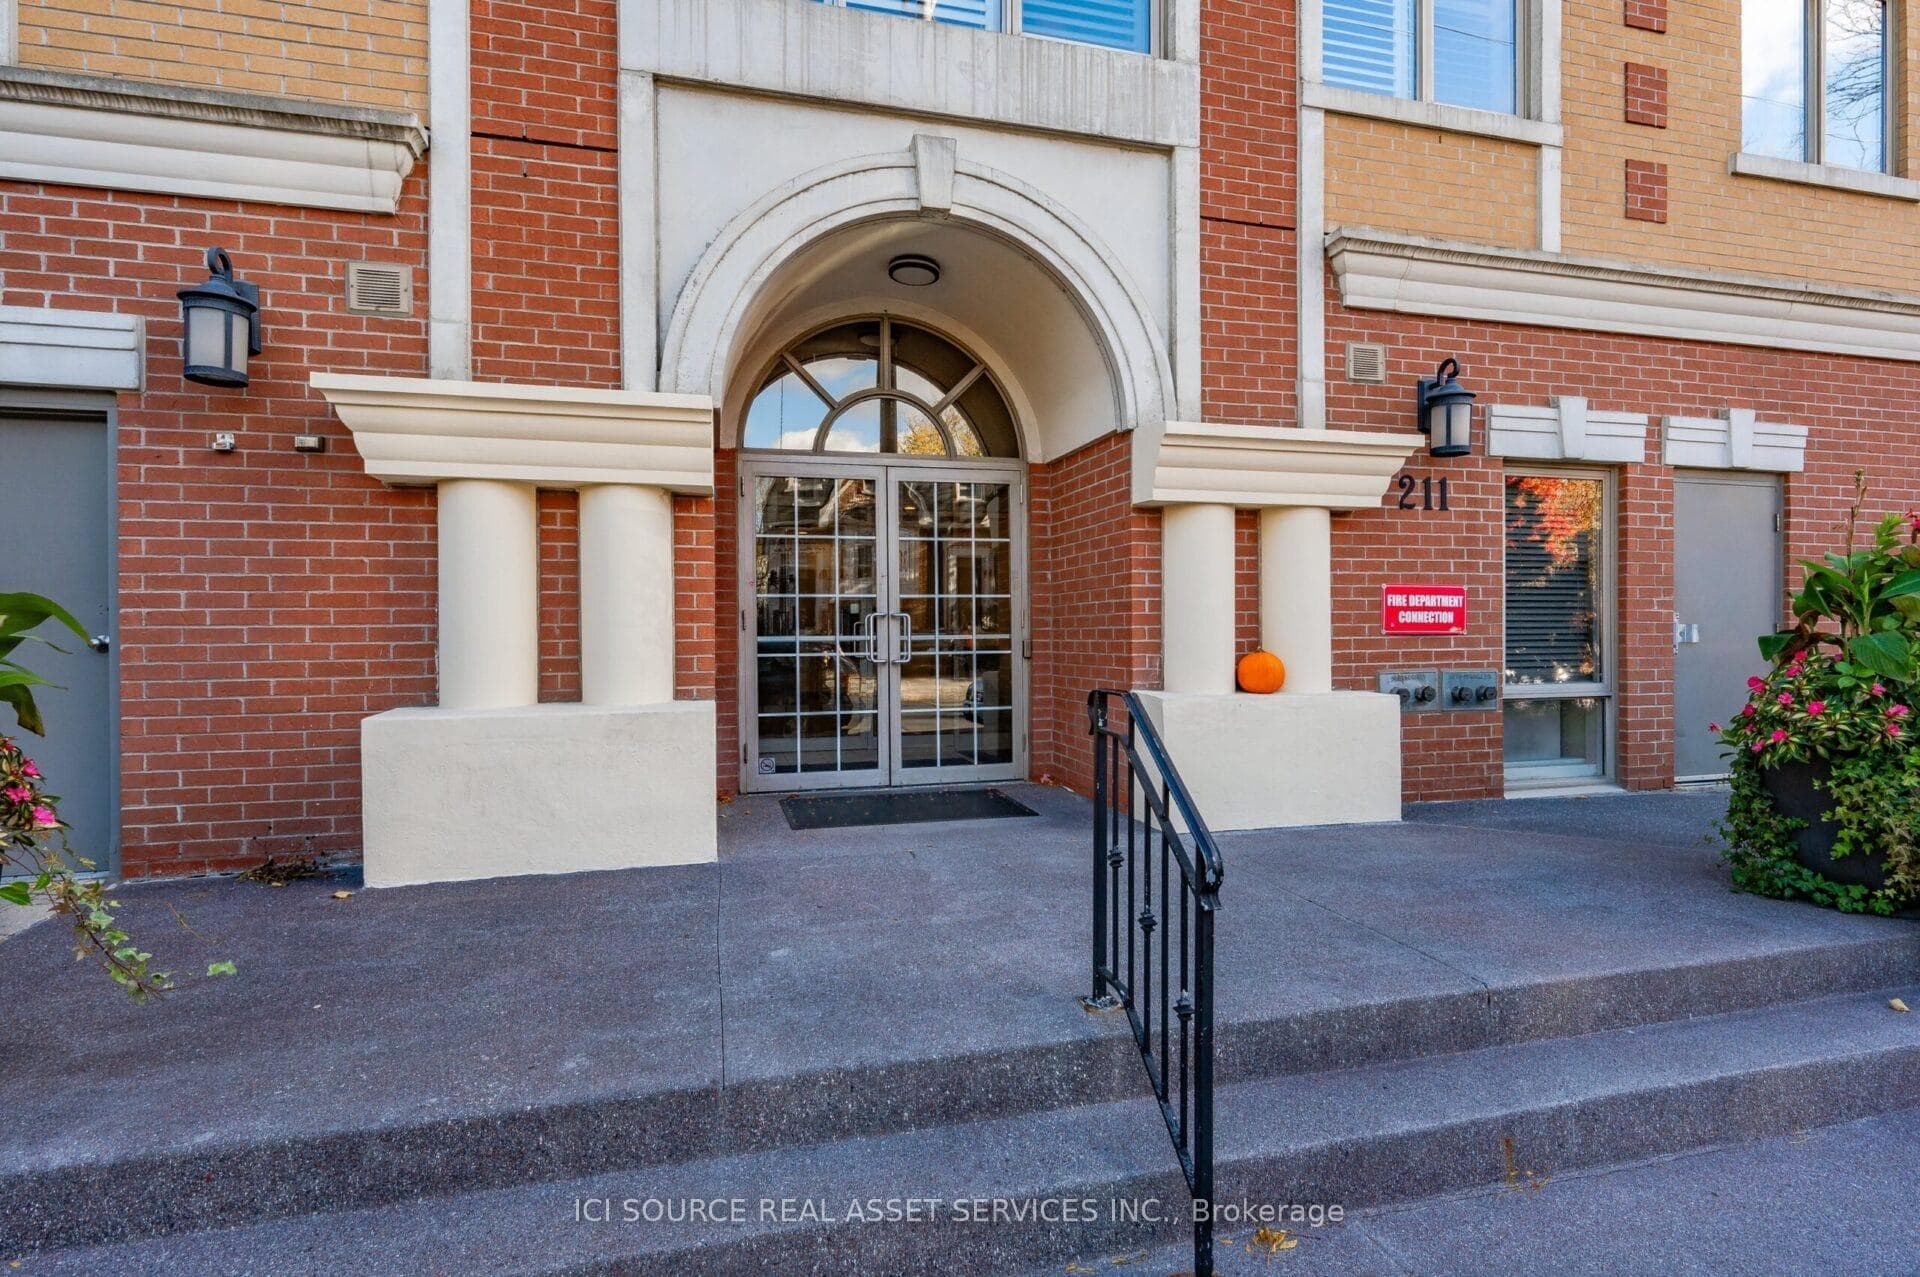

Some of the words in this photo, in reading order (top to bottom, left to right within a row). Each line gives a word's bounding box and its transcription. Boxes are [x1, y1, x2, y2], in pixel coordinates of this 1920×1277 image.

[1399, 474, 1449, 511] 211
[1387, 594, 1408, 607] FIRE
[1408, 594, 1464, 608] DEPARTMENT
[1398, 610, 1454, 623] CONNECTION
